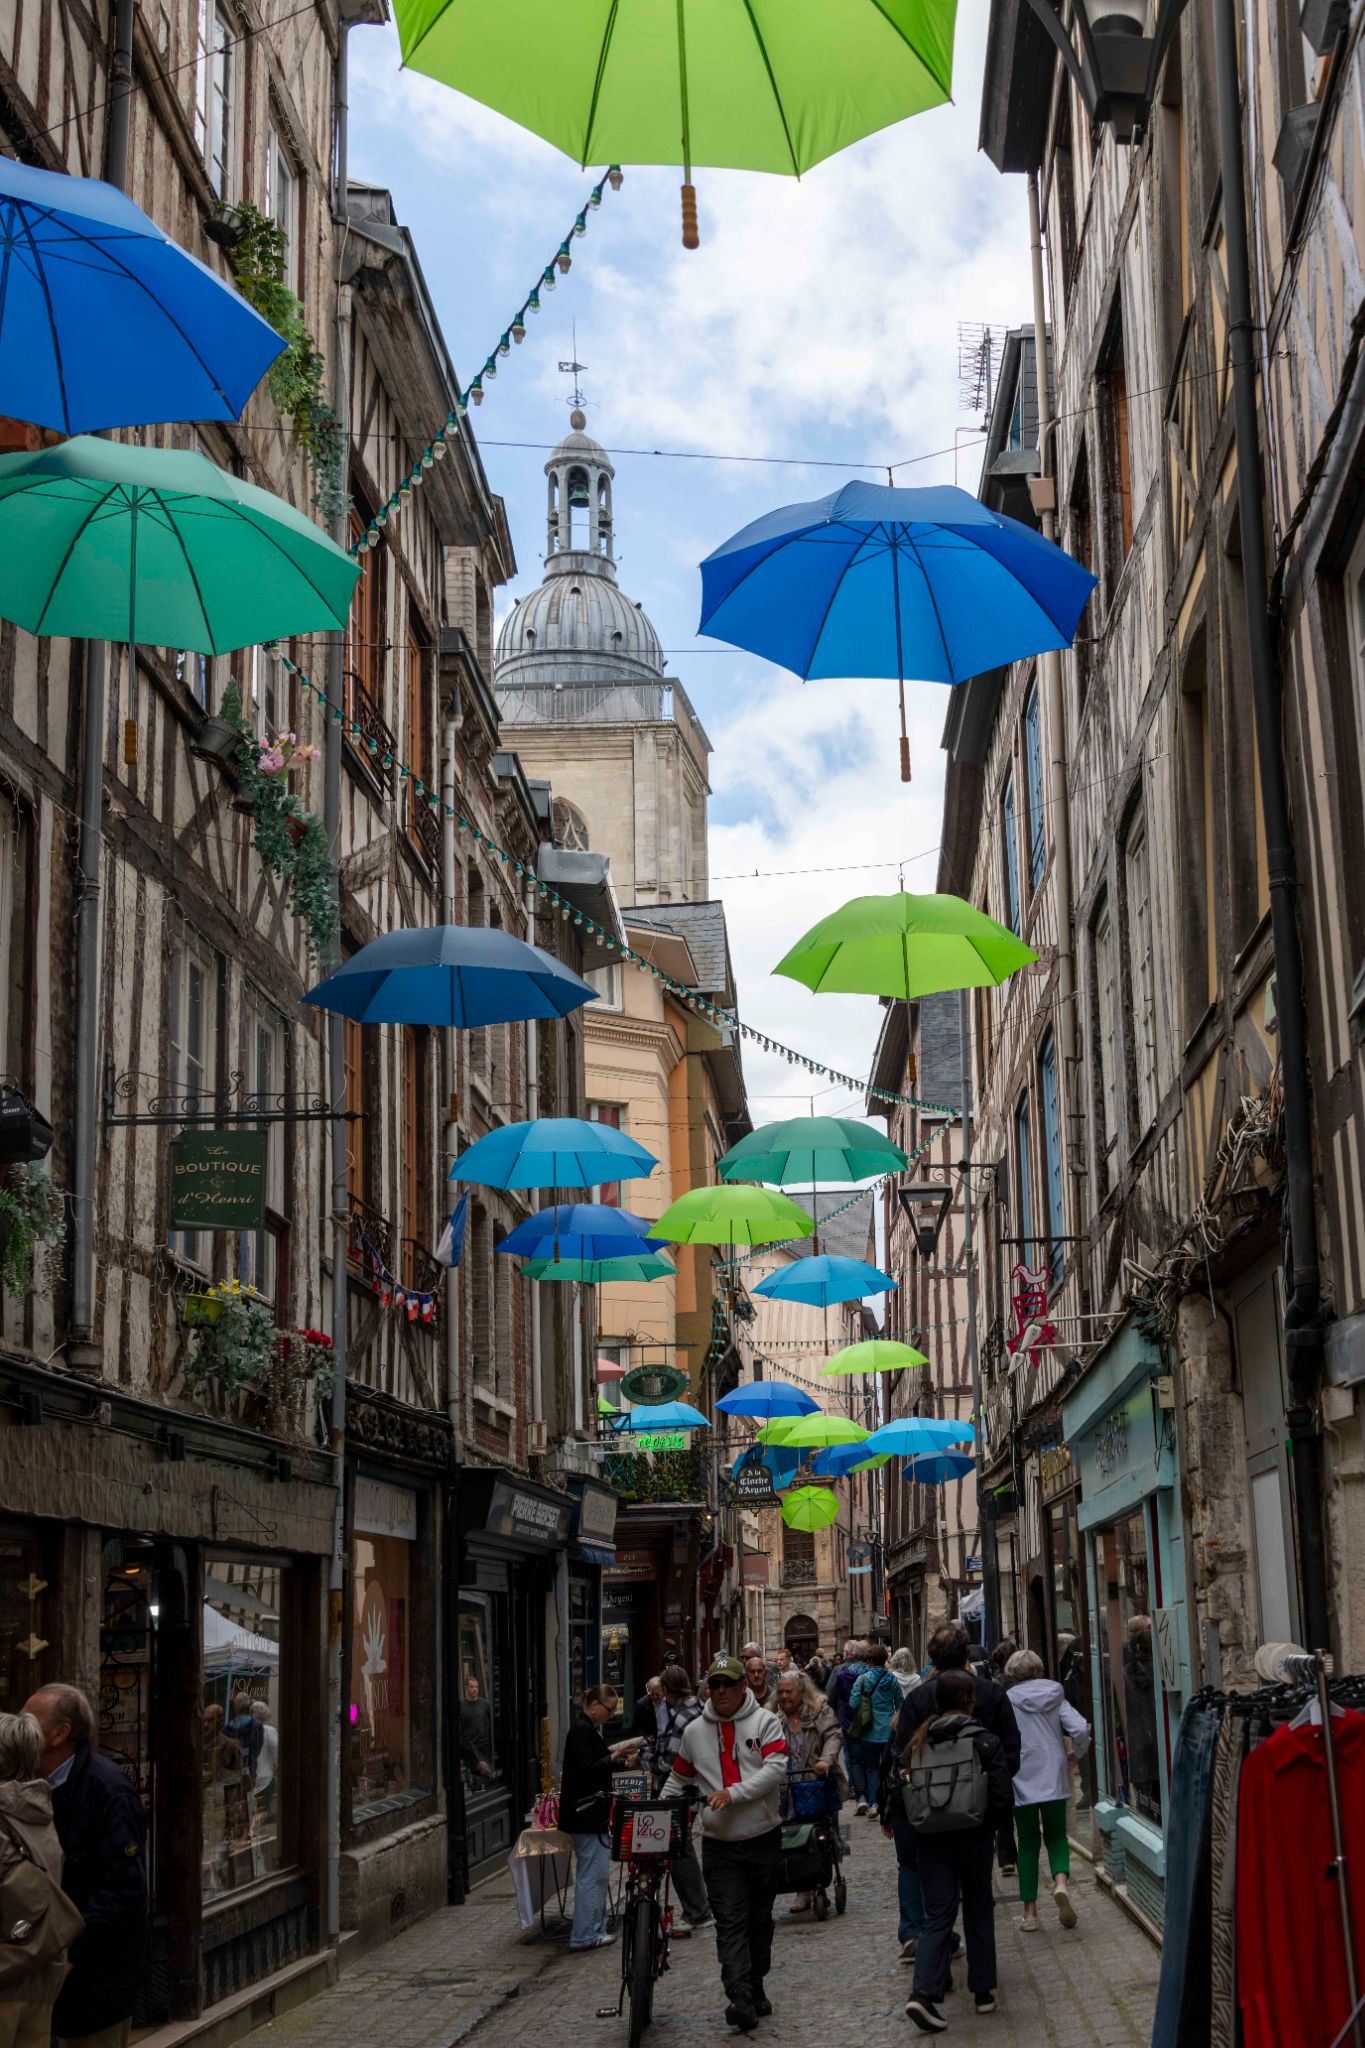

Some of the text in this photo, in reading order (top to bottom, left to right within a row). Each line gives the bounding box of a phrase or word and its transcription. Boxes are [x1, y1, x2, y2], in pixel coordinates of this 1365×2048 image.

[207, 1145, 229, 1155] La
[175, 1161, 262, 1175] BOUTIQUE
[177, 1192, 255, 1205] d'Henri
[740, 1477, 769, 1486] Cloche
[738, 1485, 771, 1495] d'Argent
[511, 1494, 538, 1523] PIERRE
